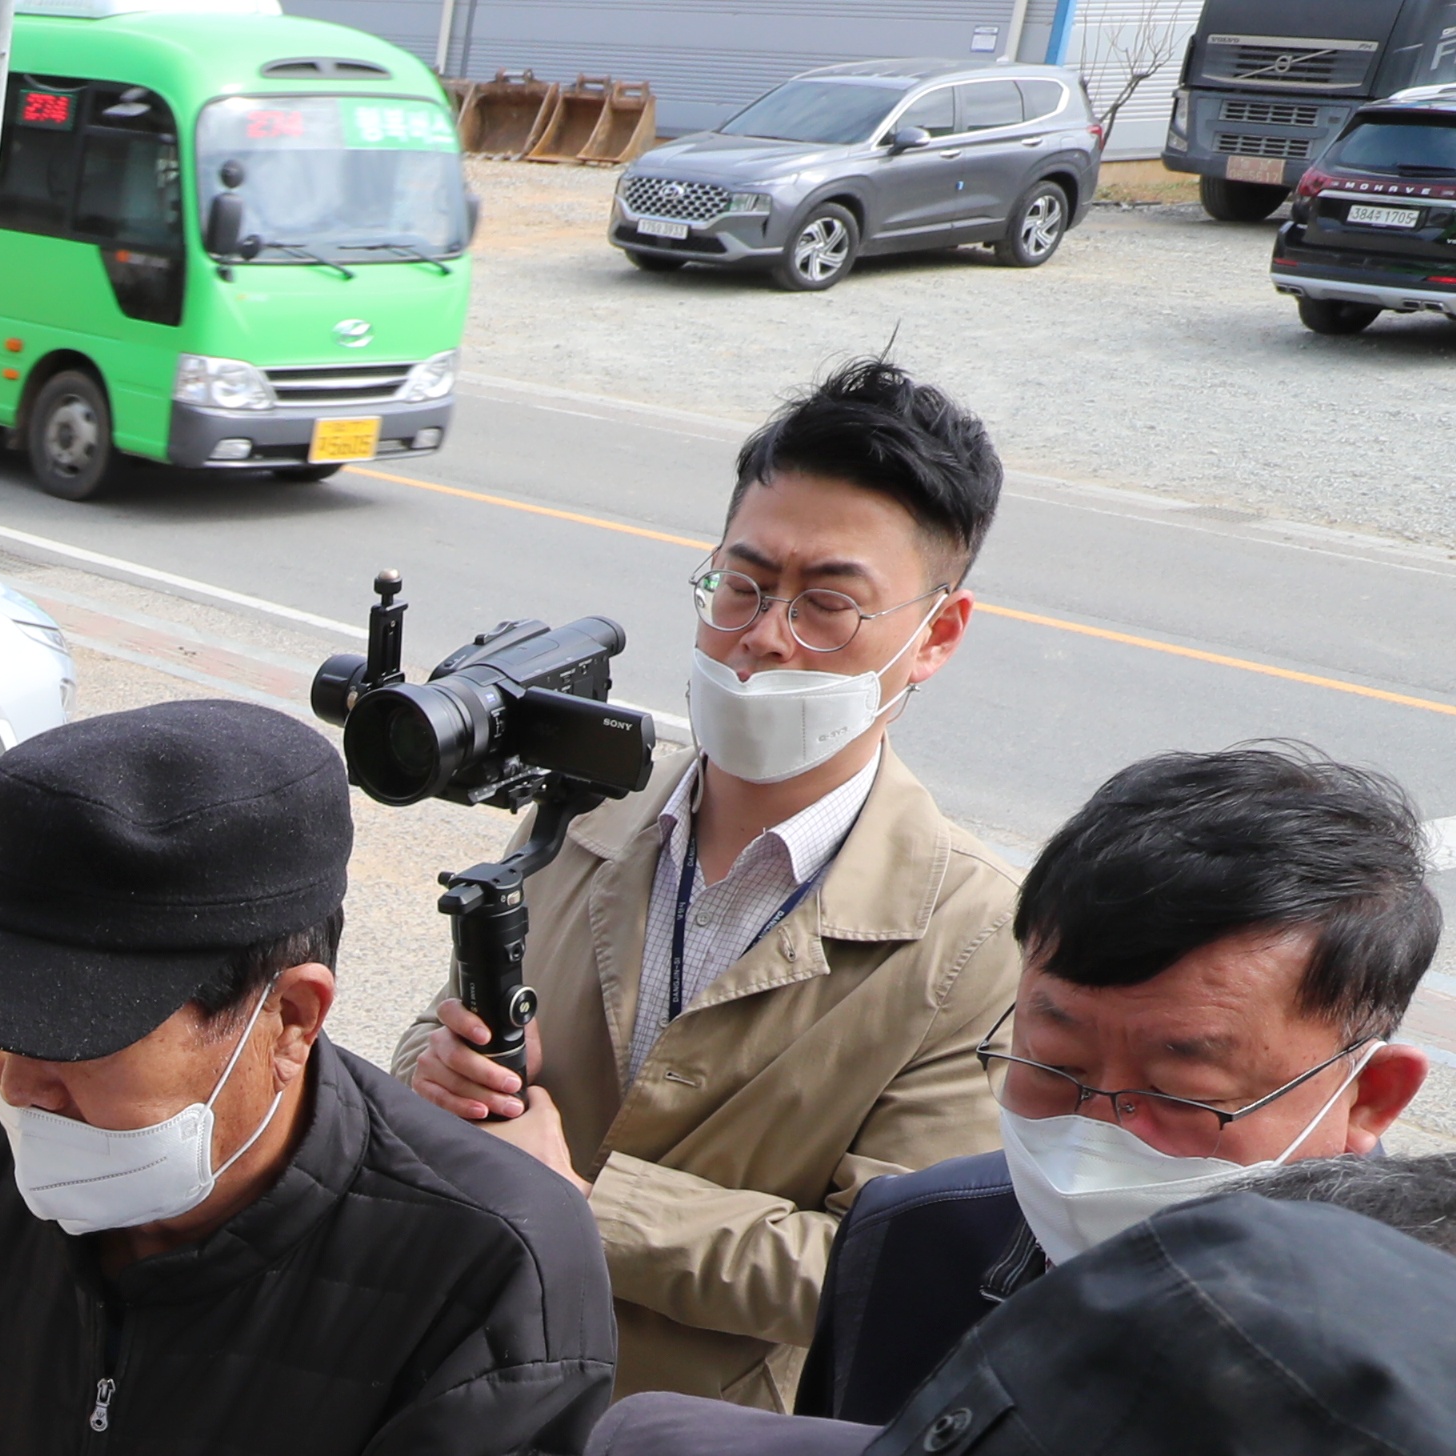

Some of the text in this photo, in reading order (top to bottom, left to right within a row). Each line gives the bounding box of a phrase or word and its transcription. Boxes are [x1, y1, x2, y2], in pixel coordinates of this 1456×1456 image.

[1344, 181, 1432, 196] MOHAVE
[1385, 210, 1414, 225] 1705
[602, 717, 633, 731] SONY
